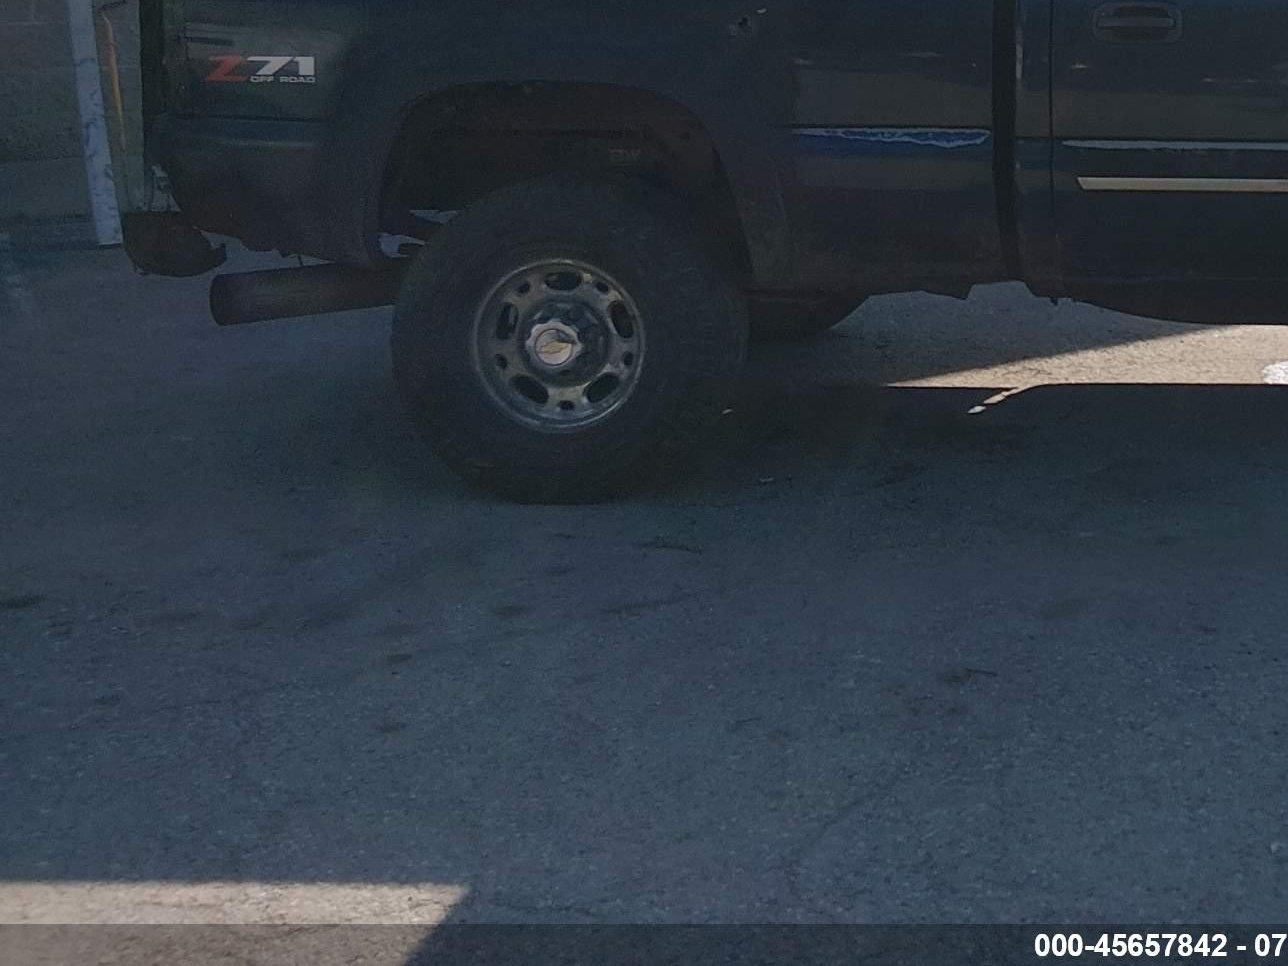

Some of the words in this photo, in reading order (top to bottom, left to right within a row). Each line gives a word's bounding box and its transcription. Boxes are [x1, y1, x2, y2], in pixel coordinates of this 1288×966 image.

[206, 54, 316, 83] Z71
[249, 75, 275, 84] OFF
[279, 75, 316, 84] ROAD
